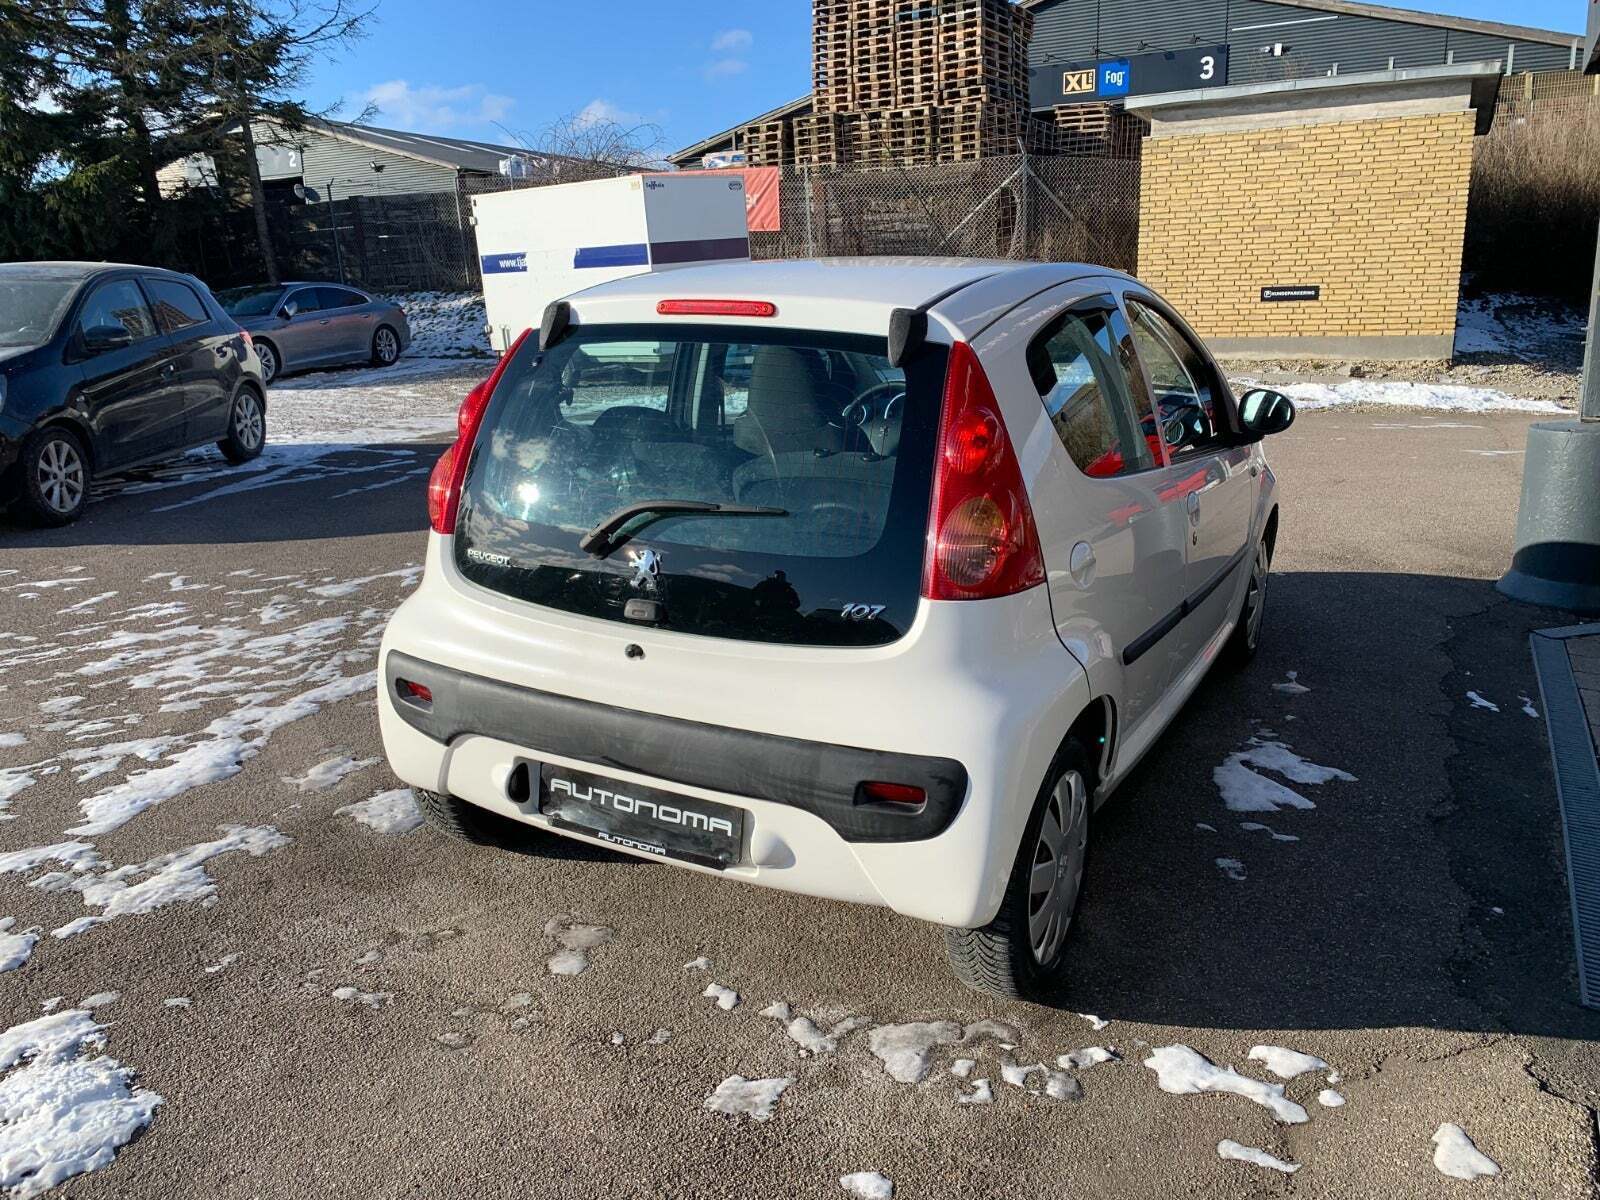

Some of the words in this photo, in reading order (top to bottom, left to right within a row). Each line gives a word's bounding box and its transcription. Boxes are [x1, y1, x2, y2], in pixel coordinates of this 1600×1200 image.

[1200, 55, 1215, 80] 3
[288, 151, 297, 168] 2
[467, 548, 511, 565] PEUGEOT
[841, 603, 886, 619] 107
[550, 778, 733, 837] AUTONOMA
[598, 831, 666, 856] AUTONOMA
